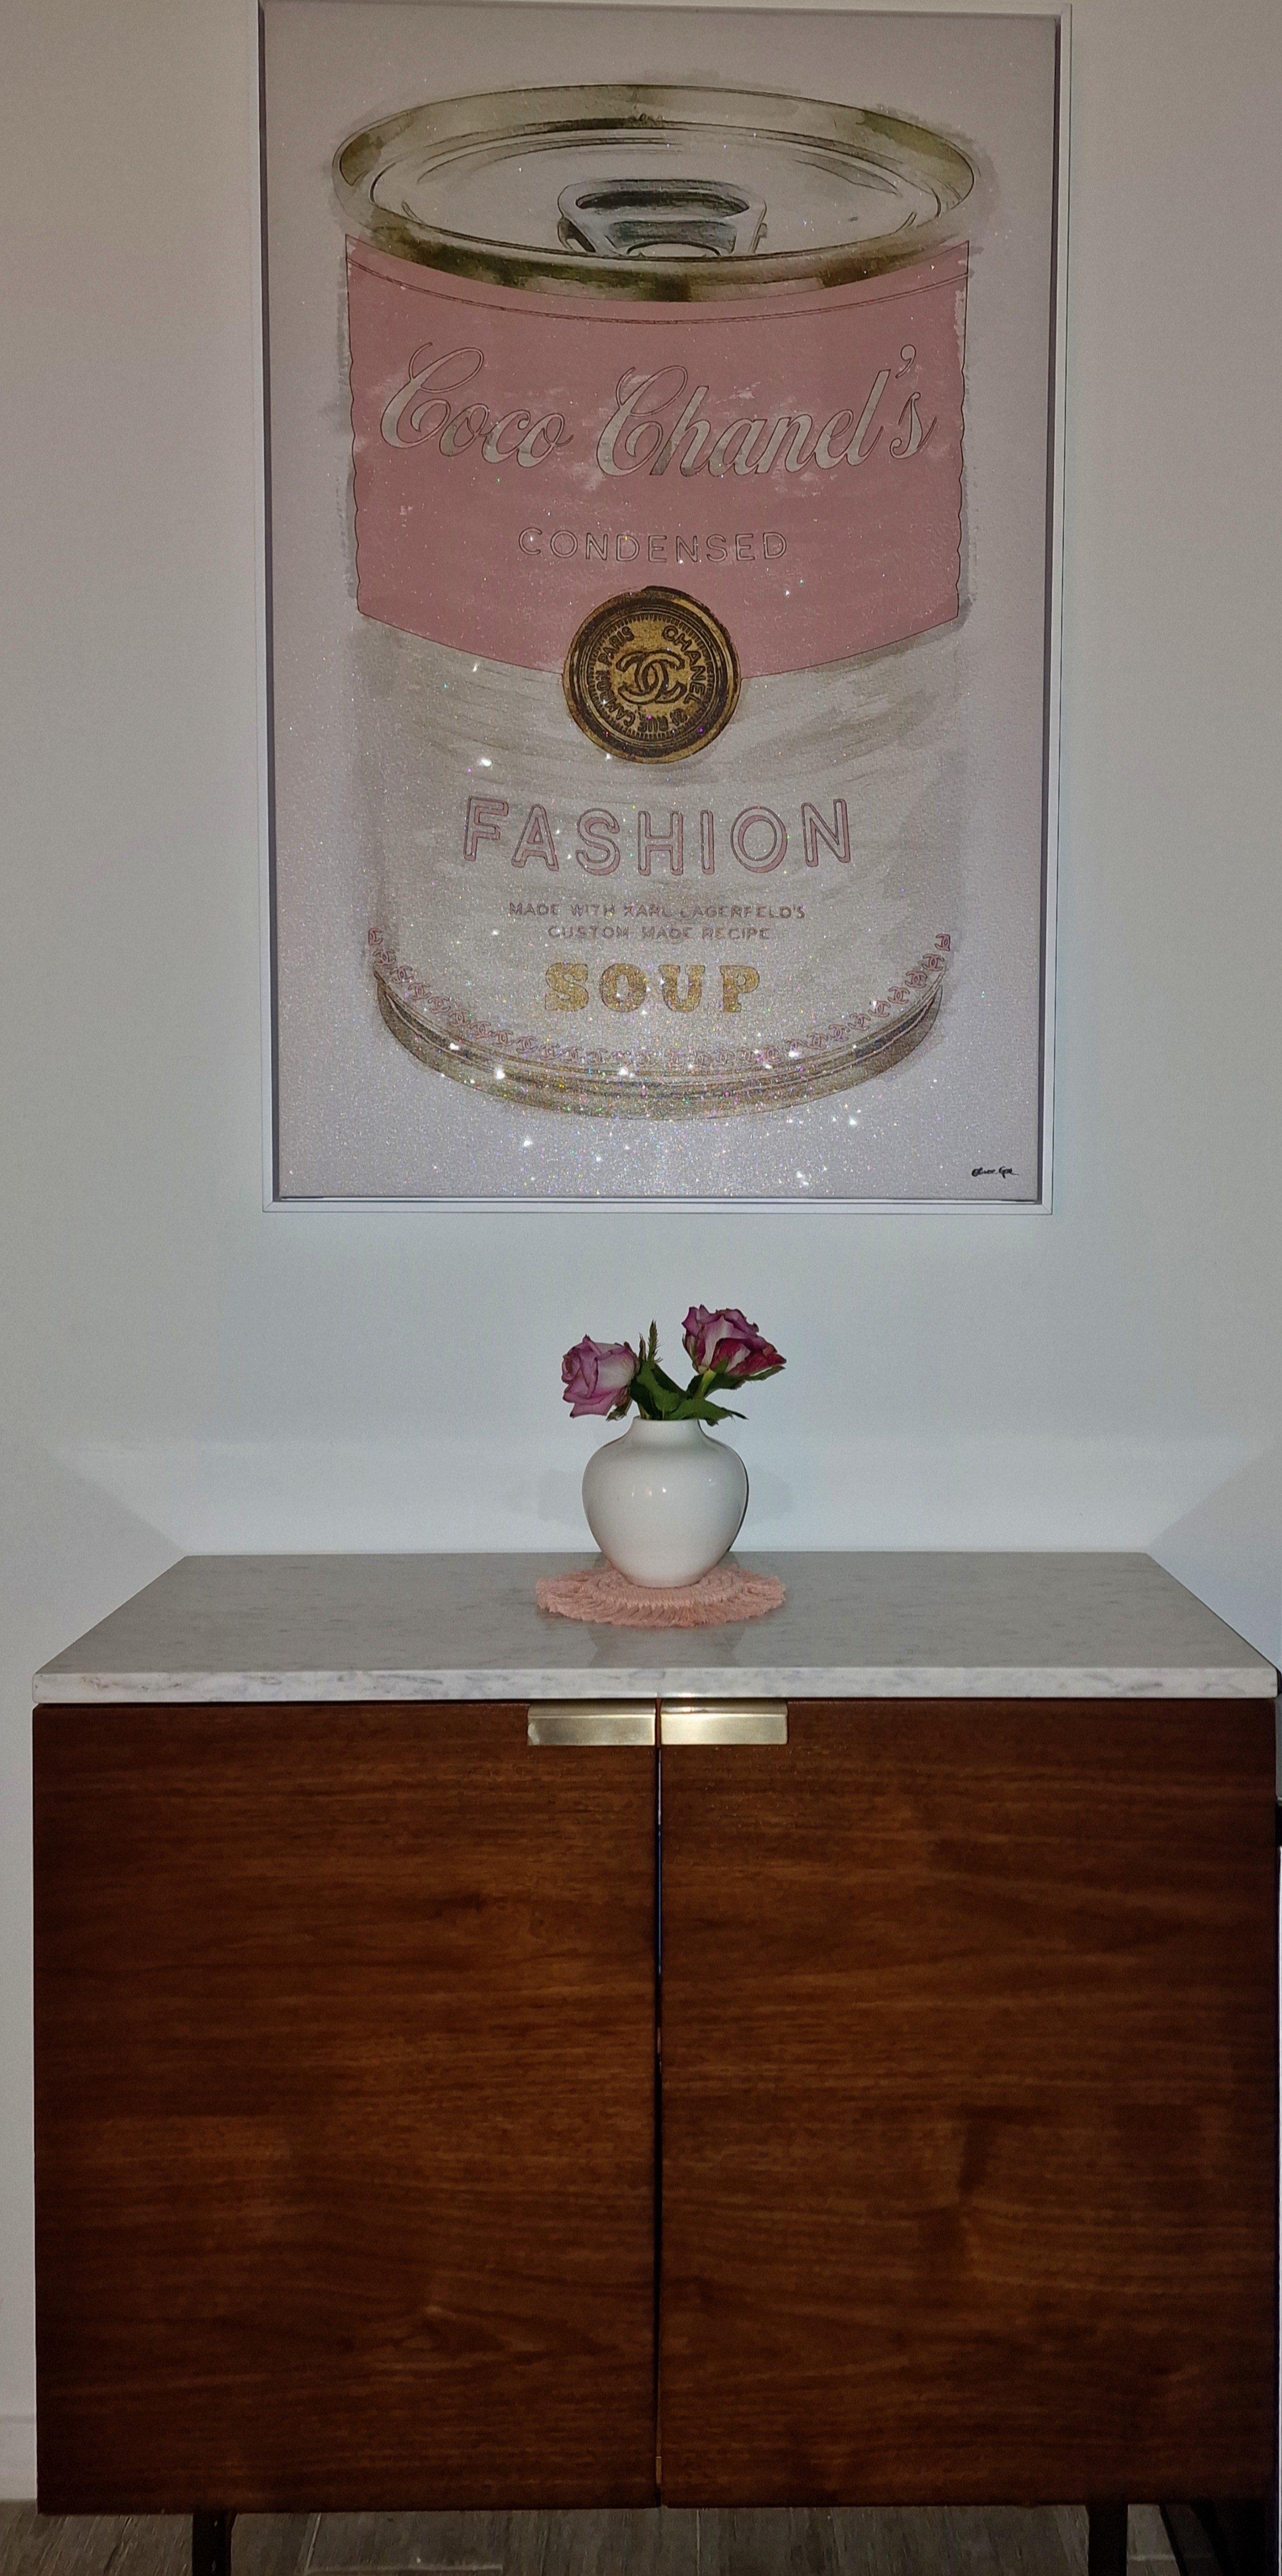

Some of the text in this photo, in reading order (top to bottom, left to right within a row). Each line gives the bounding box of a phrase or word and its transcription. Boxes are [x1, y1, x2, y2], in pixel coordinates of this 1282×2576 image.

[381, 342, 937, 477] Coco Chanel's
[518, 527, 787, 563] CONDENSED
[598, 626, 635, 666] PARIS
[661, 625, 707, 704] CHANEL
[637, 714, 669, 732] RUE
[462, 796, 852, 876] FASHION
[509, 902, 560, 916] MADE
[570, 903, 615, 917] WITH
[680, 905, 806, 919] LAGERFELD'S
[702, 926, 770, 940] RECIPE
[544, 962, 760, 1013] SOUP
